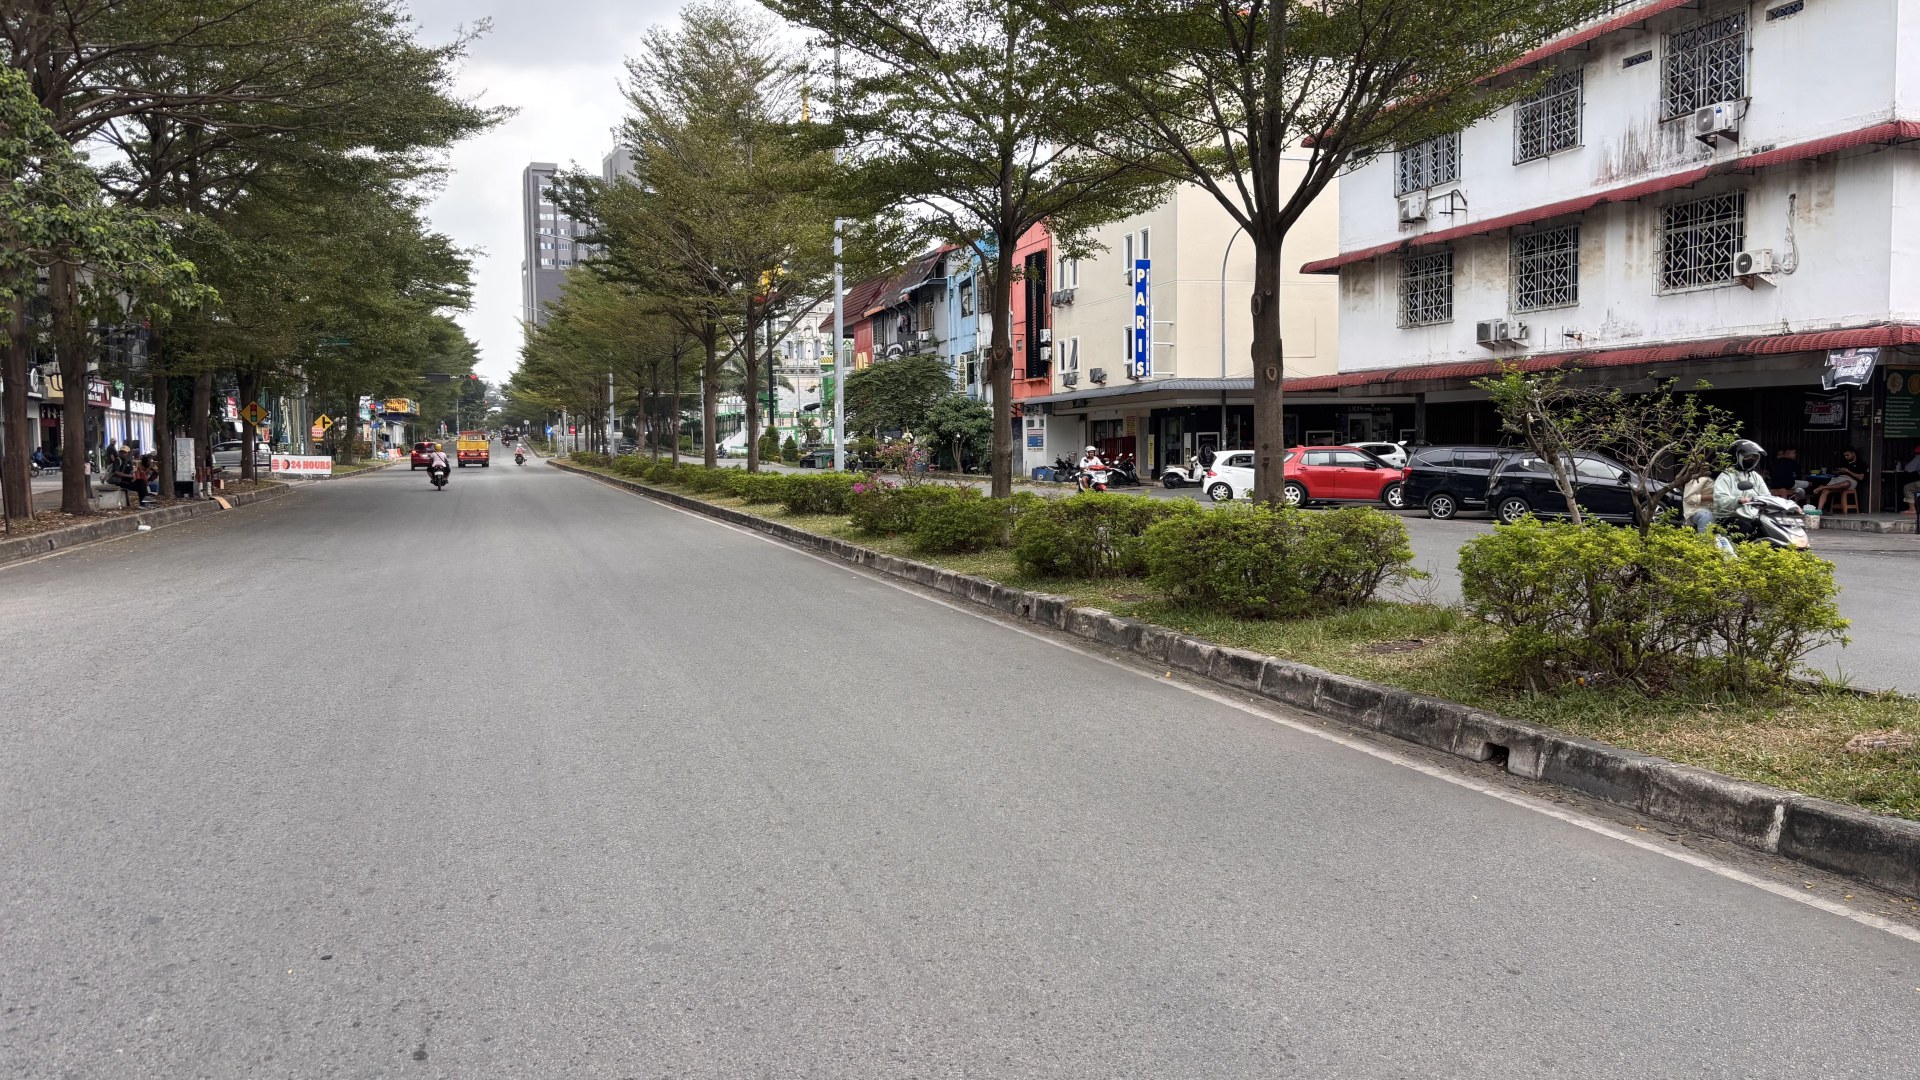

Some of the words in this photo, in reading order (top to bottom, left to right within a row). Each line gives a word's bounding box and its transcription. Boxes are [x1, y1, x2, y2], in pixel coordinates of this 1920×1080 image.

[1136, 268, 1145, 376] PARIS
[291, 460, 302, 469] 24
[302, 460, 331, 470] HOURS
